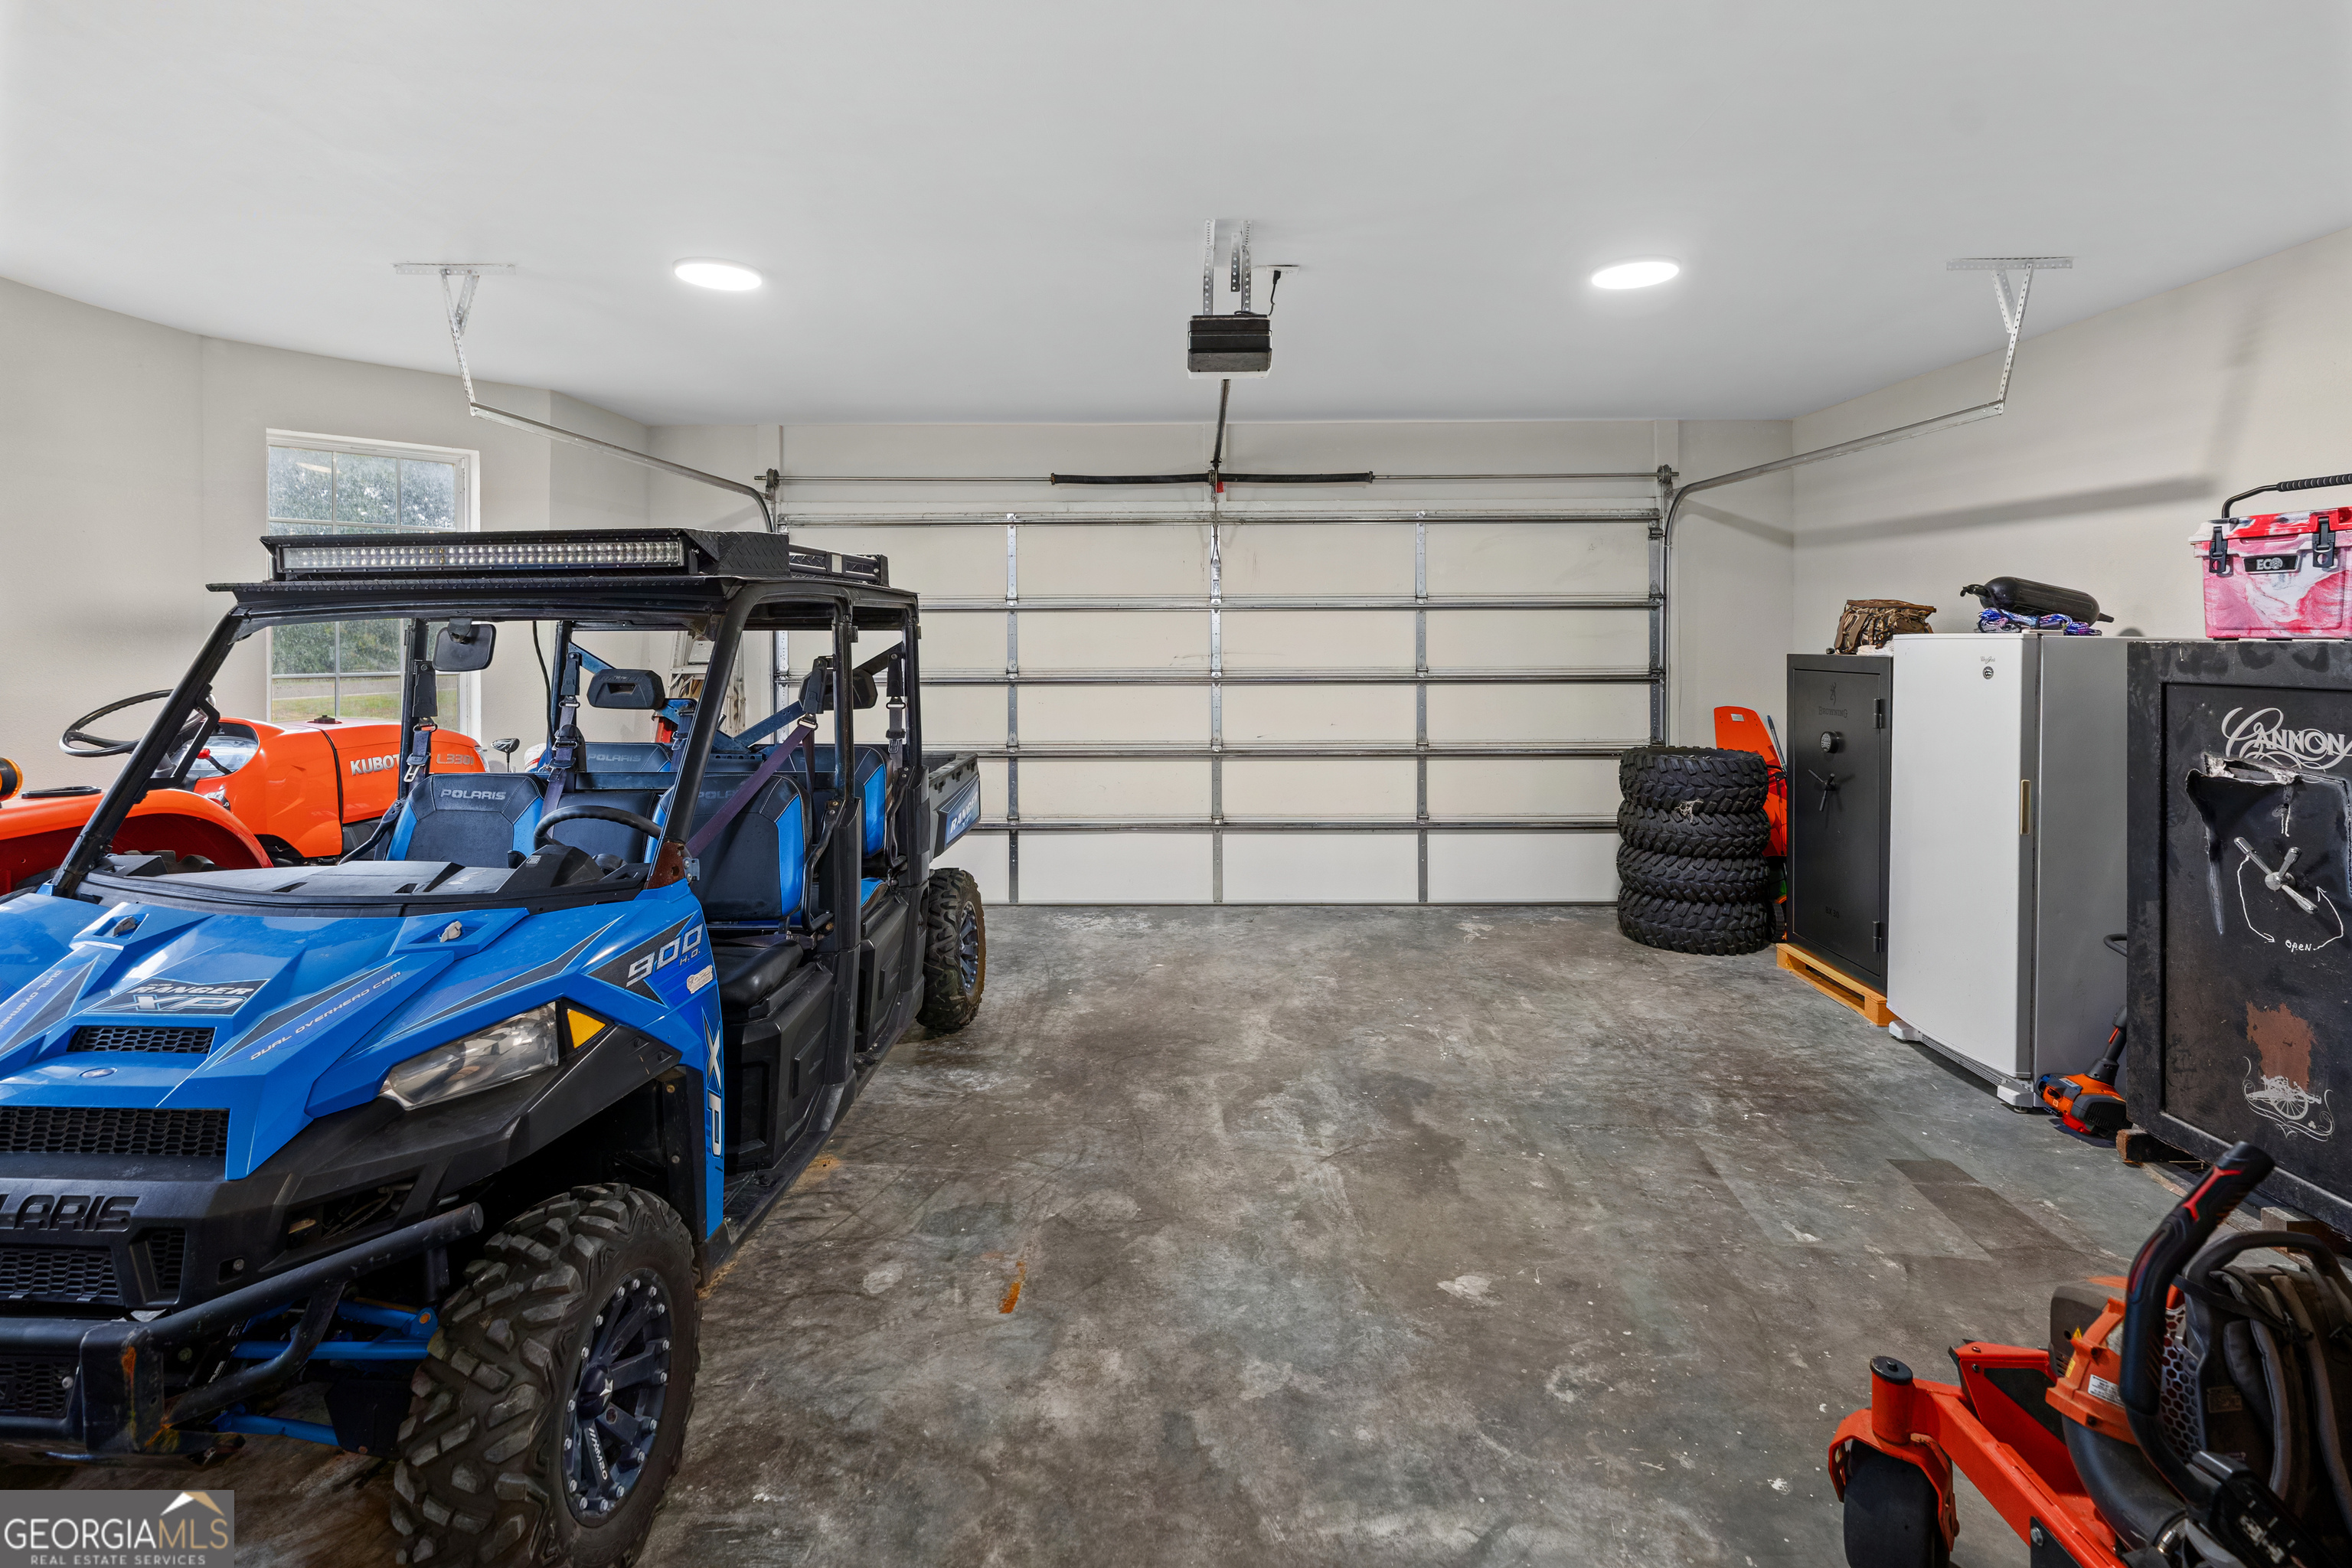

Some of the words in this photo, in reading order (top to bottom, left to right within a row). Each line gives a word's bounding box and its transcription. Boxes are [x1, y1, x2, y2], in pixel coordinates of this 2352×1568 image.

[1818, 706, 1848, 718] BROWNING
[2221, 707, 2350, 764] CANNON
[350, 753, 400, 776] KUBOT
[587, 753, 642, 763] POLARIS
[440, 789, 507, 801] POLARIS
[697, 789, 737, 800] POLA
[950, 791, 978, 835] RANGER
[626, 923, 704, 988] 900
[100, 995, 247, 1011] XP
[126, 986, 254, 995] RANGER
[0, 991, 38, 1030] OVERHE
[250, 1035, 292, 1060] DUAL
[295, 988, 371, 1034] OVERHEAD
[373, 971, 401, 989] CAM
[701, 1006, 722, 1158] XP
[0, 1194, 142, 1233] LARIS
